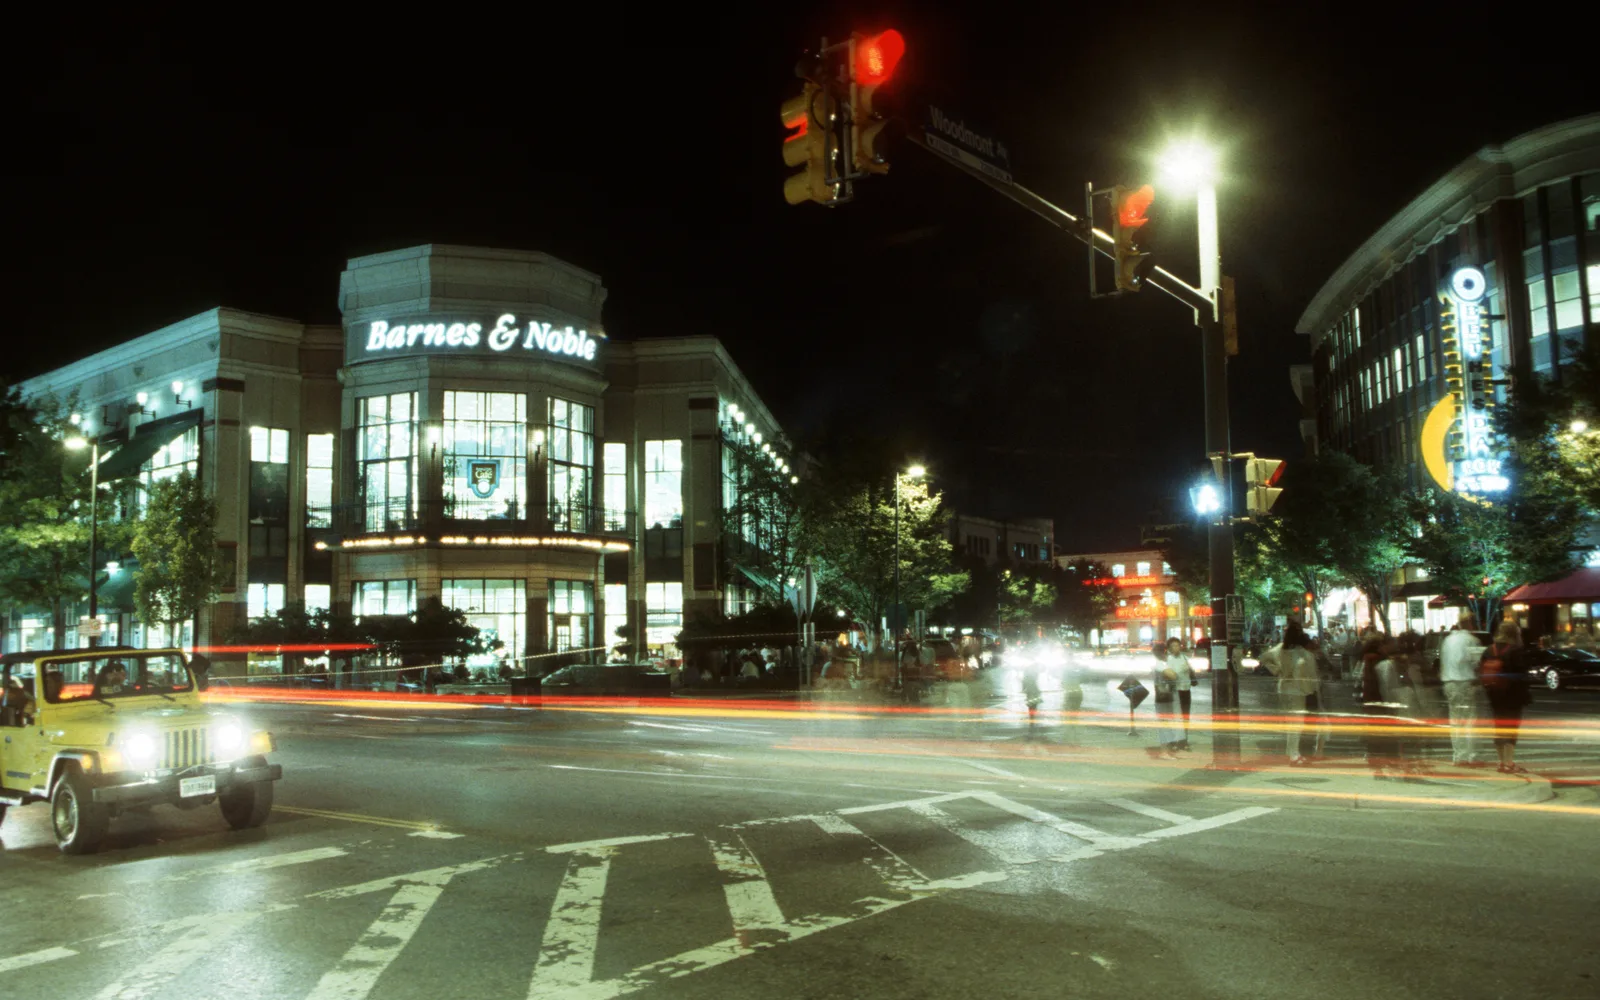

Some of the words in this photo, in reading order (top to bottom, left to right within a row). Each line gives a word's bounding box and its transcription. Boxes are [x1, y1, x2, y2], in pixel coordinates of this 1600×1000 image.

[929, 104, 995, 157] Woodmont
[366, 320, 482, 351] Barnes
[488, 313, 519, 352] &
[523, 320, 596, 360] Noble
